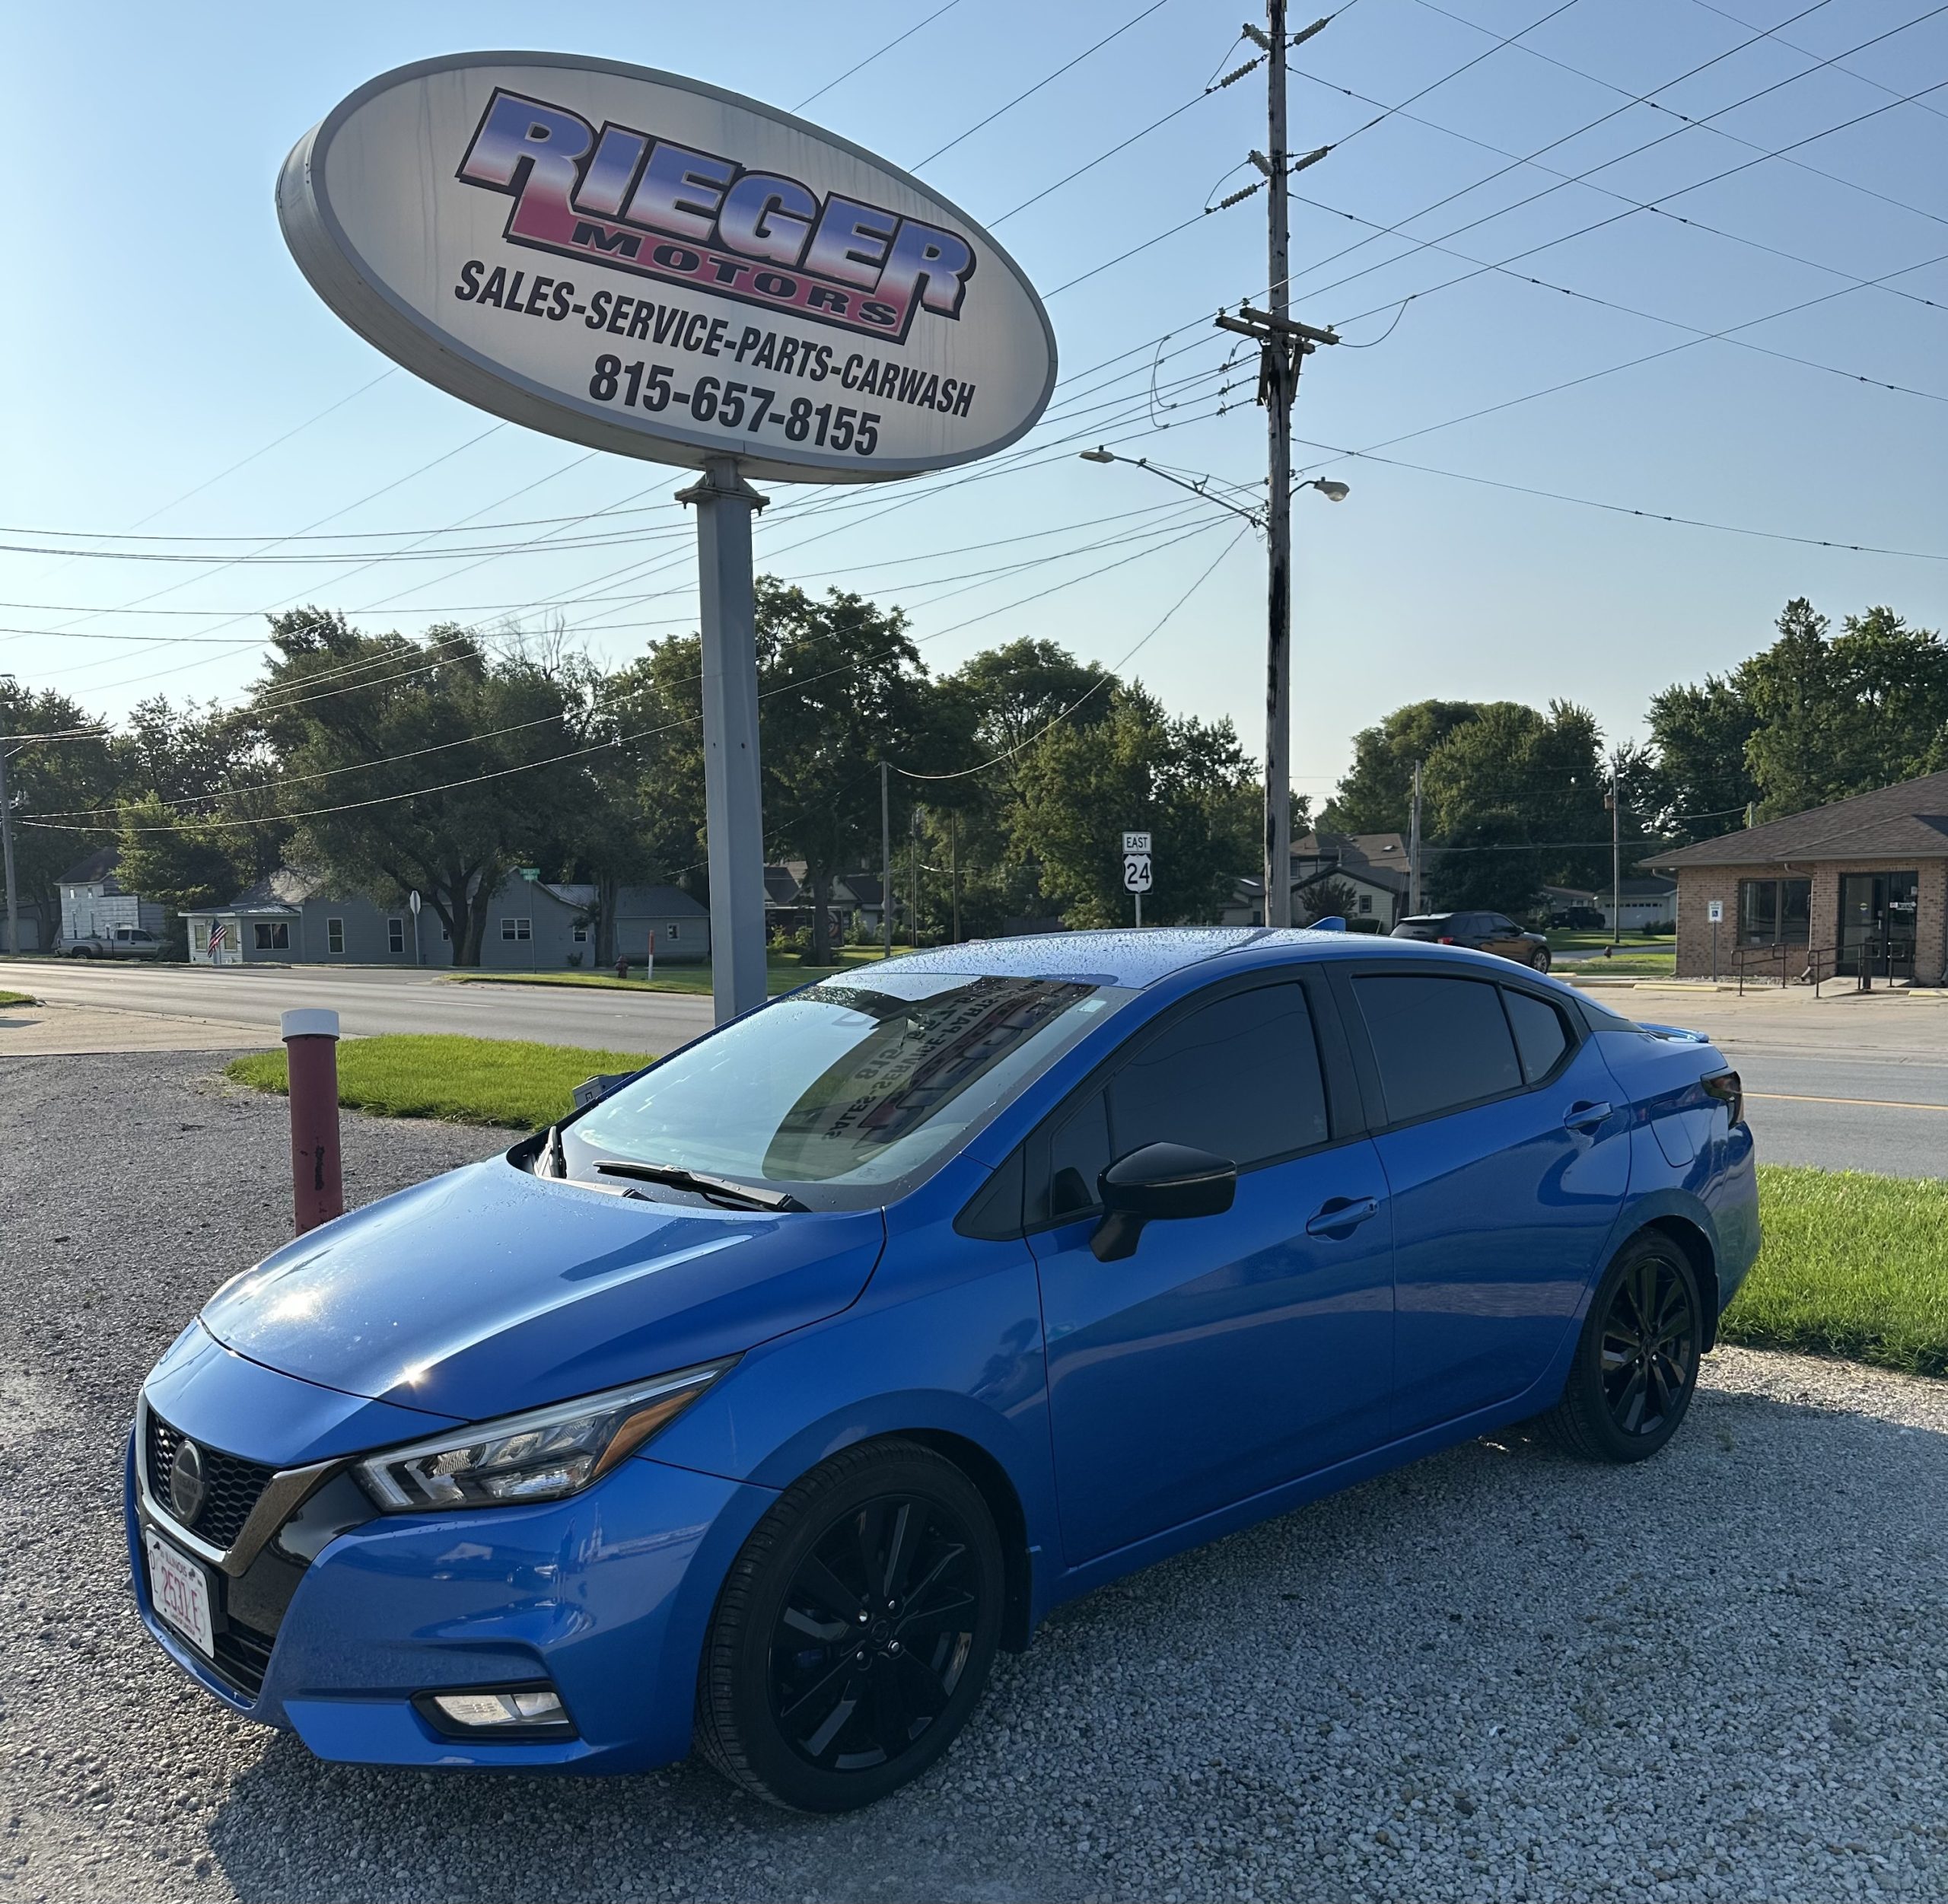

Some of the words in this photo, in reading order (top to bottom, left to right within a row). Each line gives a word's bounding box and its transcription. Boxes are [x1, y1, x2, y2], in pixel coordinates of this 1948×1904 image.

[456, 87, 976, 320] RIEGER
[571, 221, 896, 326] MOTORS
[454, 259, 976, 418] SALES-SERVICE-PARTS-CARWASH
[589, 353, 882, 456] 815-657-8155
[1126, 836, 1148, 849] EAST
[1126, 862, 1150, 884] 24
